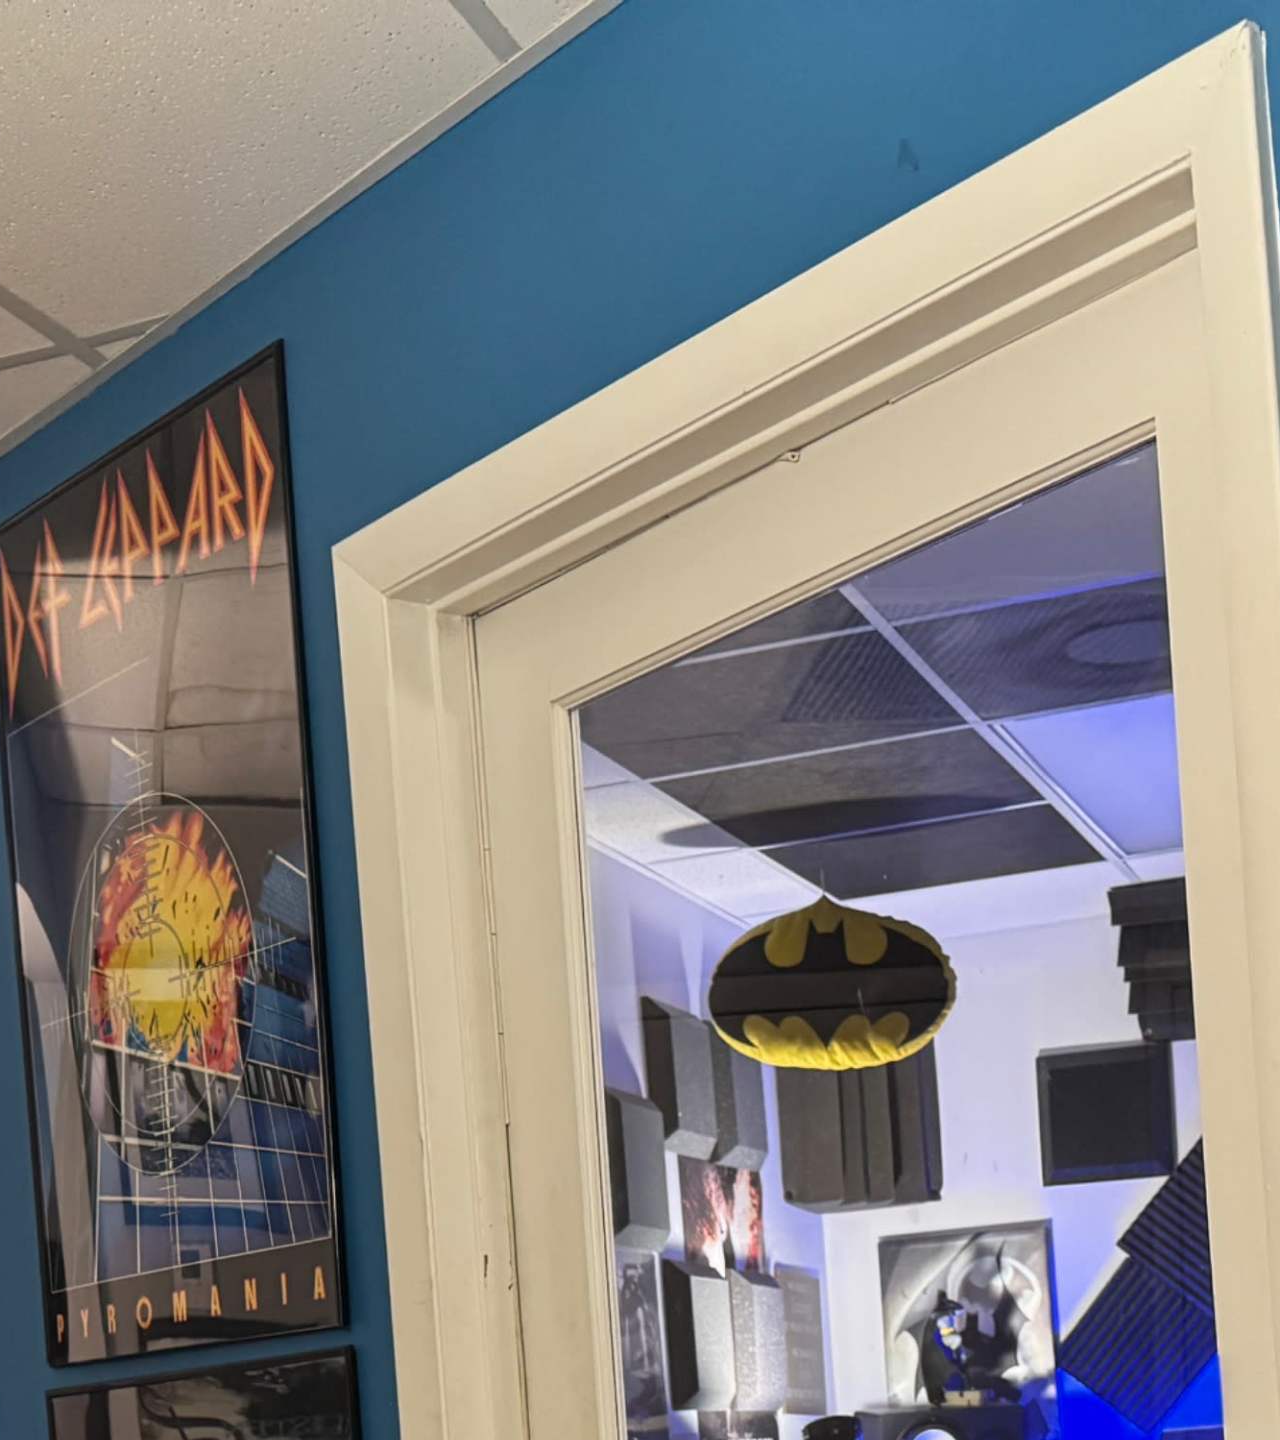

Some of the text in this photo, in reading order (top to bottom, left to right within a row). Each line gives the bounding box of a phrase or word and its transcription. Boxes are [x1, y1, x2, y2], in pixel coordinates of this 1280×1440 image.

[0, 385, 275, 722] DEF LEPPARD
[55, 1266, 327, 1343] PYROMANIA
